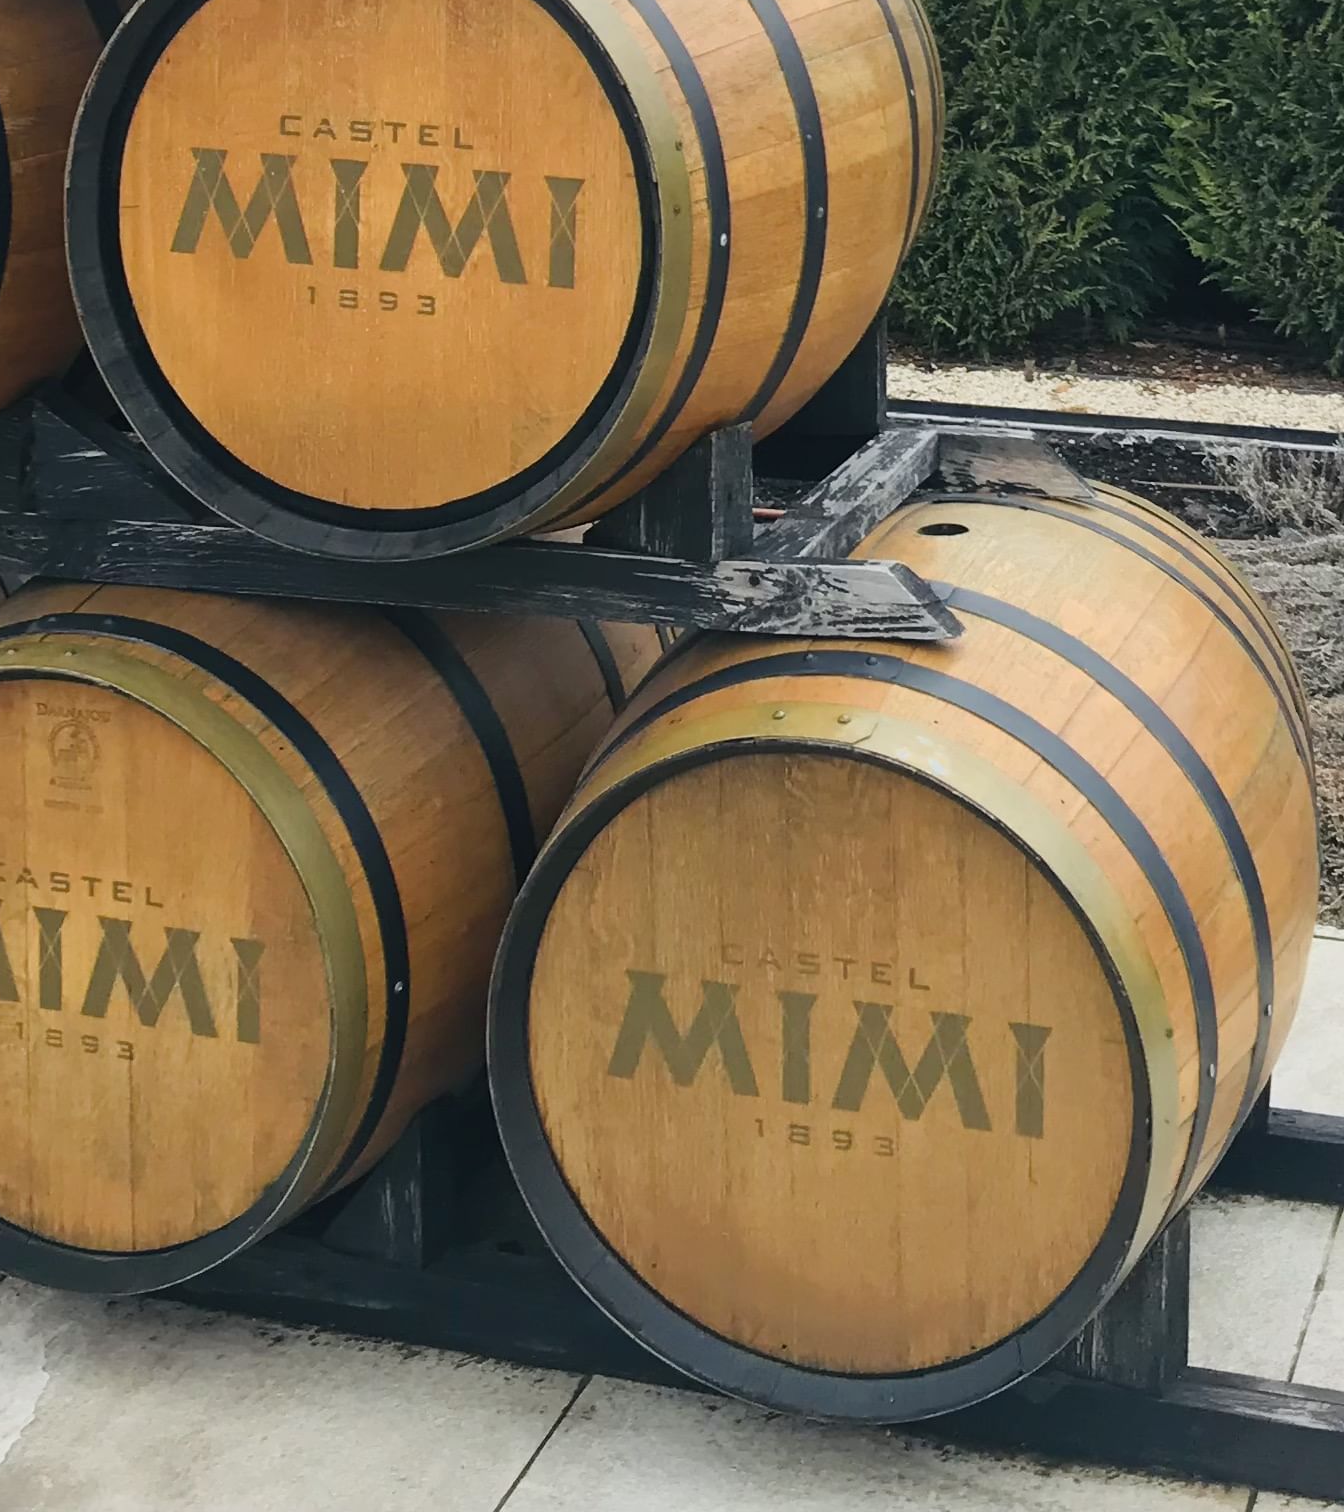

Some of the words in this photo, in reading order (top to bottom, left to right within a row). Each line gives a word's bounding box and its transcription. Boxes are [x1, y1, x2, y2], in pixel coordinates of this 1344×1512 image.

[280, 116, 475, 150] CASTEL
[170, 149, 585, 289] MIMI
[307, 287, 436, 315] 1893
[722, 945, 932, 990] CASTEL
[16, 1023, 137, 1059] 1893
[608, 972, 1050, 1138] MIMI
[754, 1119, 898, 1156] 1893
